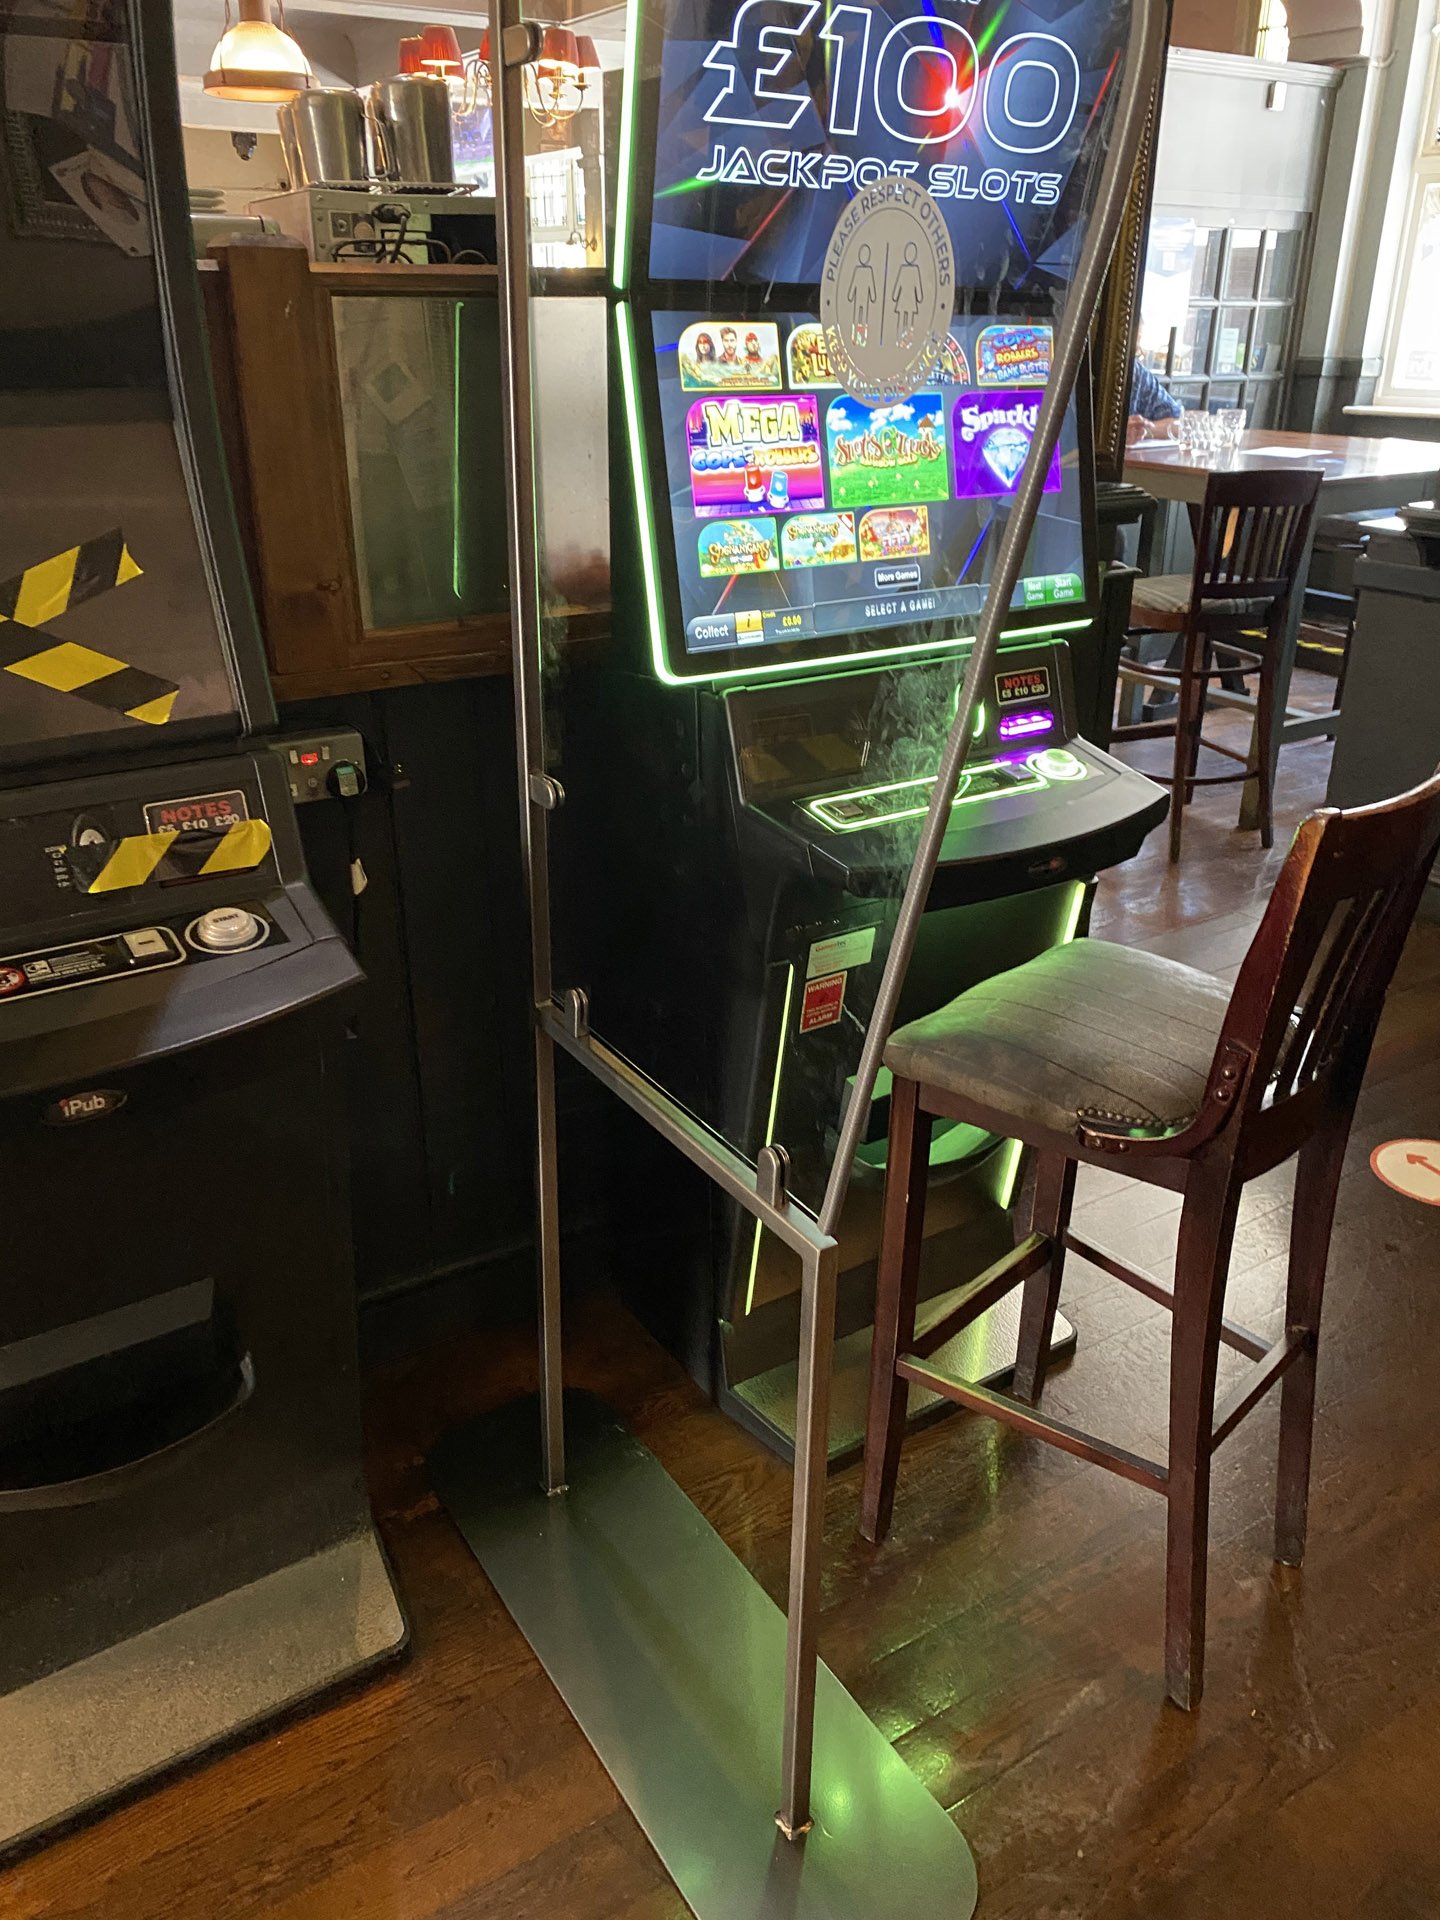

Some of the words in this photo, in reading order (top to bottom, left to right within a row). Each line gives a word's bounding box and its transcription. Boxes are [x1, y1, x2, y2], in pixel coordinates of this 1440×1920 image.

[703, 0, 1080, 153] £100
[697, 145, 919, 195] JACKPOT
[928, 164, 1063, 205] SLOTS
[826, 206, 861, 282] PLEASE
[860, 183, 922, 215] RESPECT
[920, 202, 951, 287] OTHERS
[703, 401, 802, 448] MEGA
[877, 572, 895, 582] More
[895, 570, 918, 581] Games
[1053, 576, 1072, 588] Start
[1026, 591, 1045, 601] Game
[1053, 588, 1075, 599] Game
[865, 602, 897, 617] SELECT
[901, 600, 907, 613] A
[695, 624, 729, 639] Collect
[1004, 673, 1042, 689] NOTES
[1014, 686, 1029, 697] £10
[160, 800, 232, 823] NOTES
[182, 818, 209, 831] £10
[215, 814, 240, 827] £20
[807, 977, 843, 993] WARNING
[809, 1012, 833, 1025] ALARM
[60, 1095, 105, 1118] iPub
